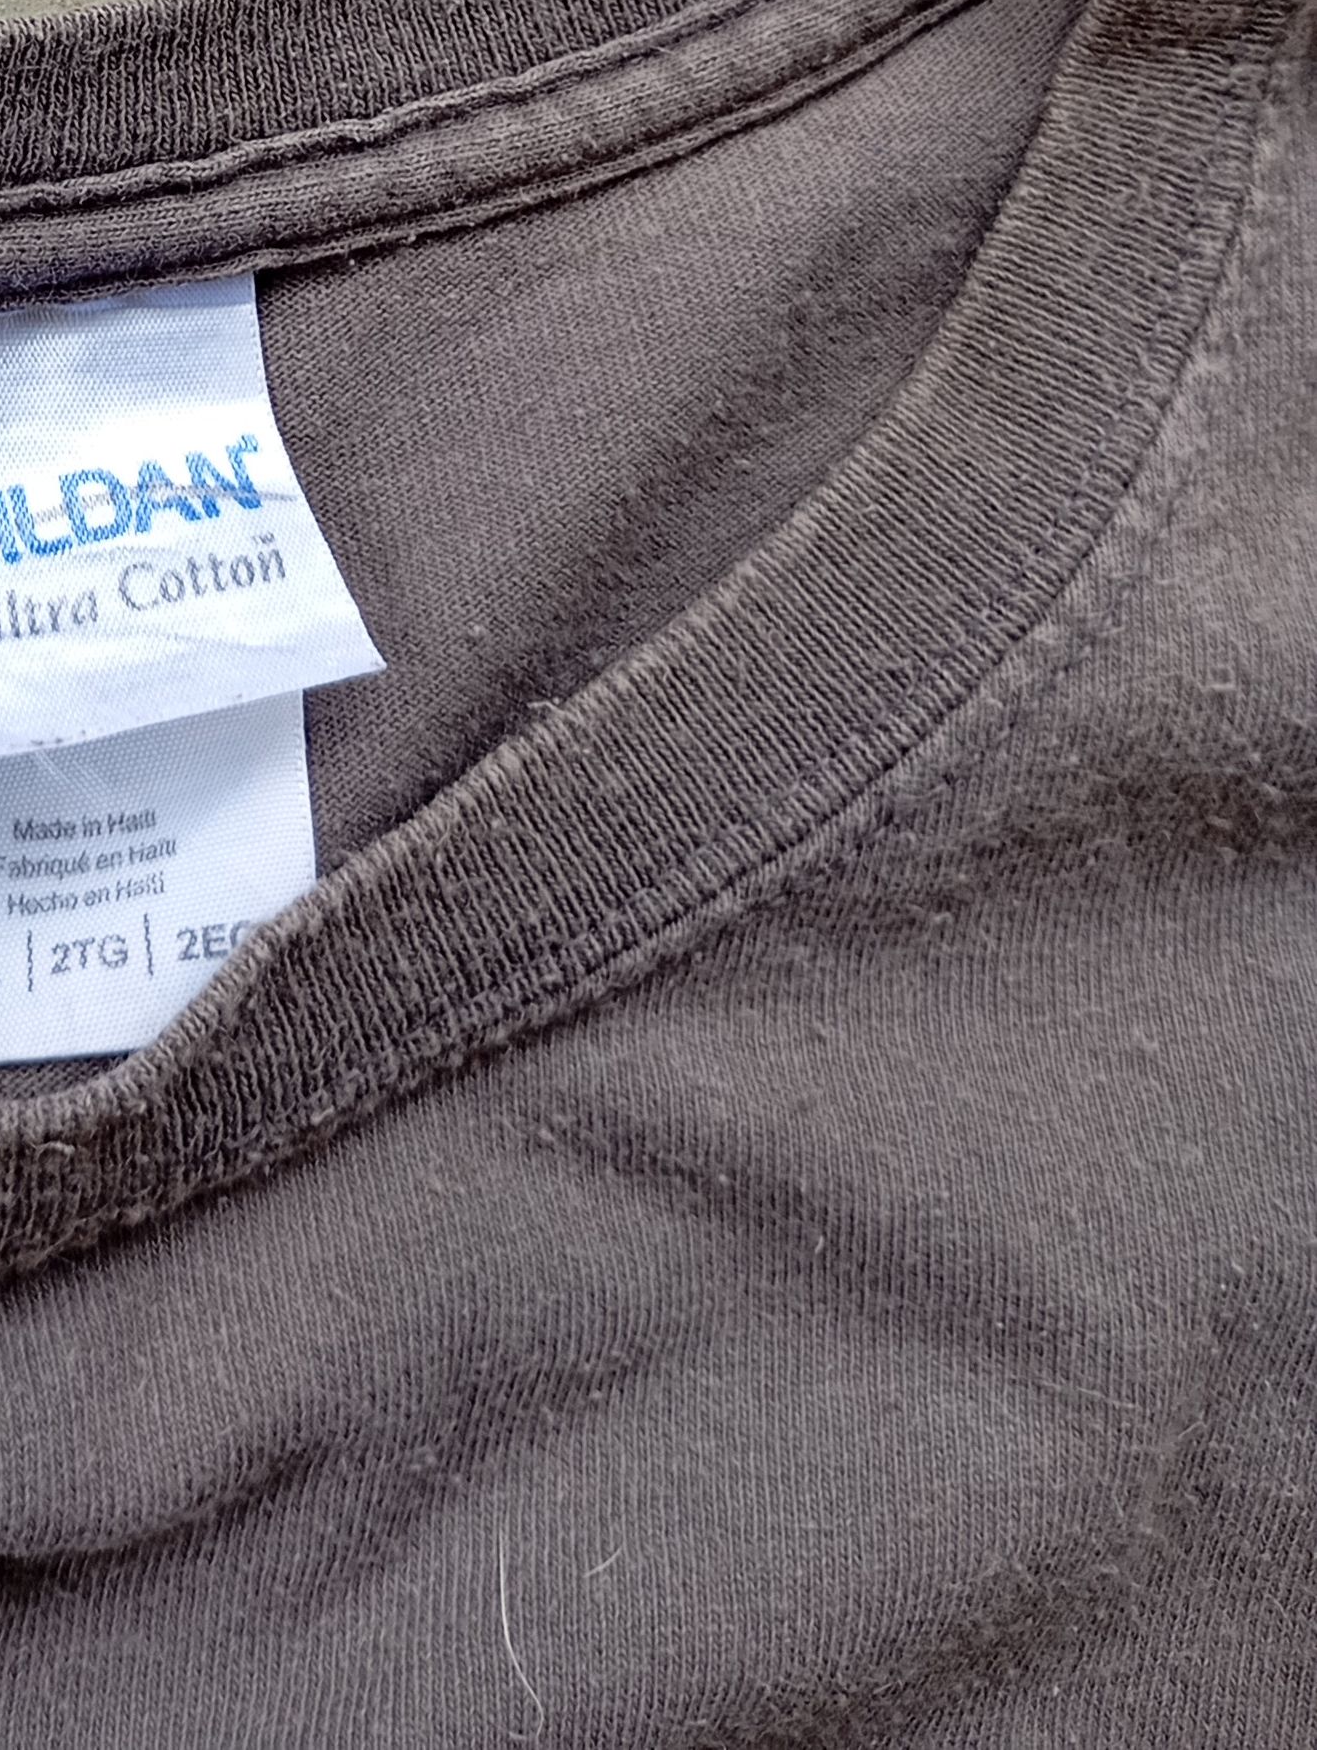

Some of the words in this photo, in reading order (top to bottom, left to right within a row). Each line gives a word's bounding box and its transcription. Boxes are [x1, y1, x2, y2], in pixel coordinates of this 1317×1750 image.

[13, 817, 76, 842] Made
[82, 815, 101, 838] in
[96, 852, 122, 870] en
[8, 892, 78, 916] Hecho
[84, 887, 110, 907] en
[51, 934, 128, 975] 2TG
